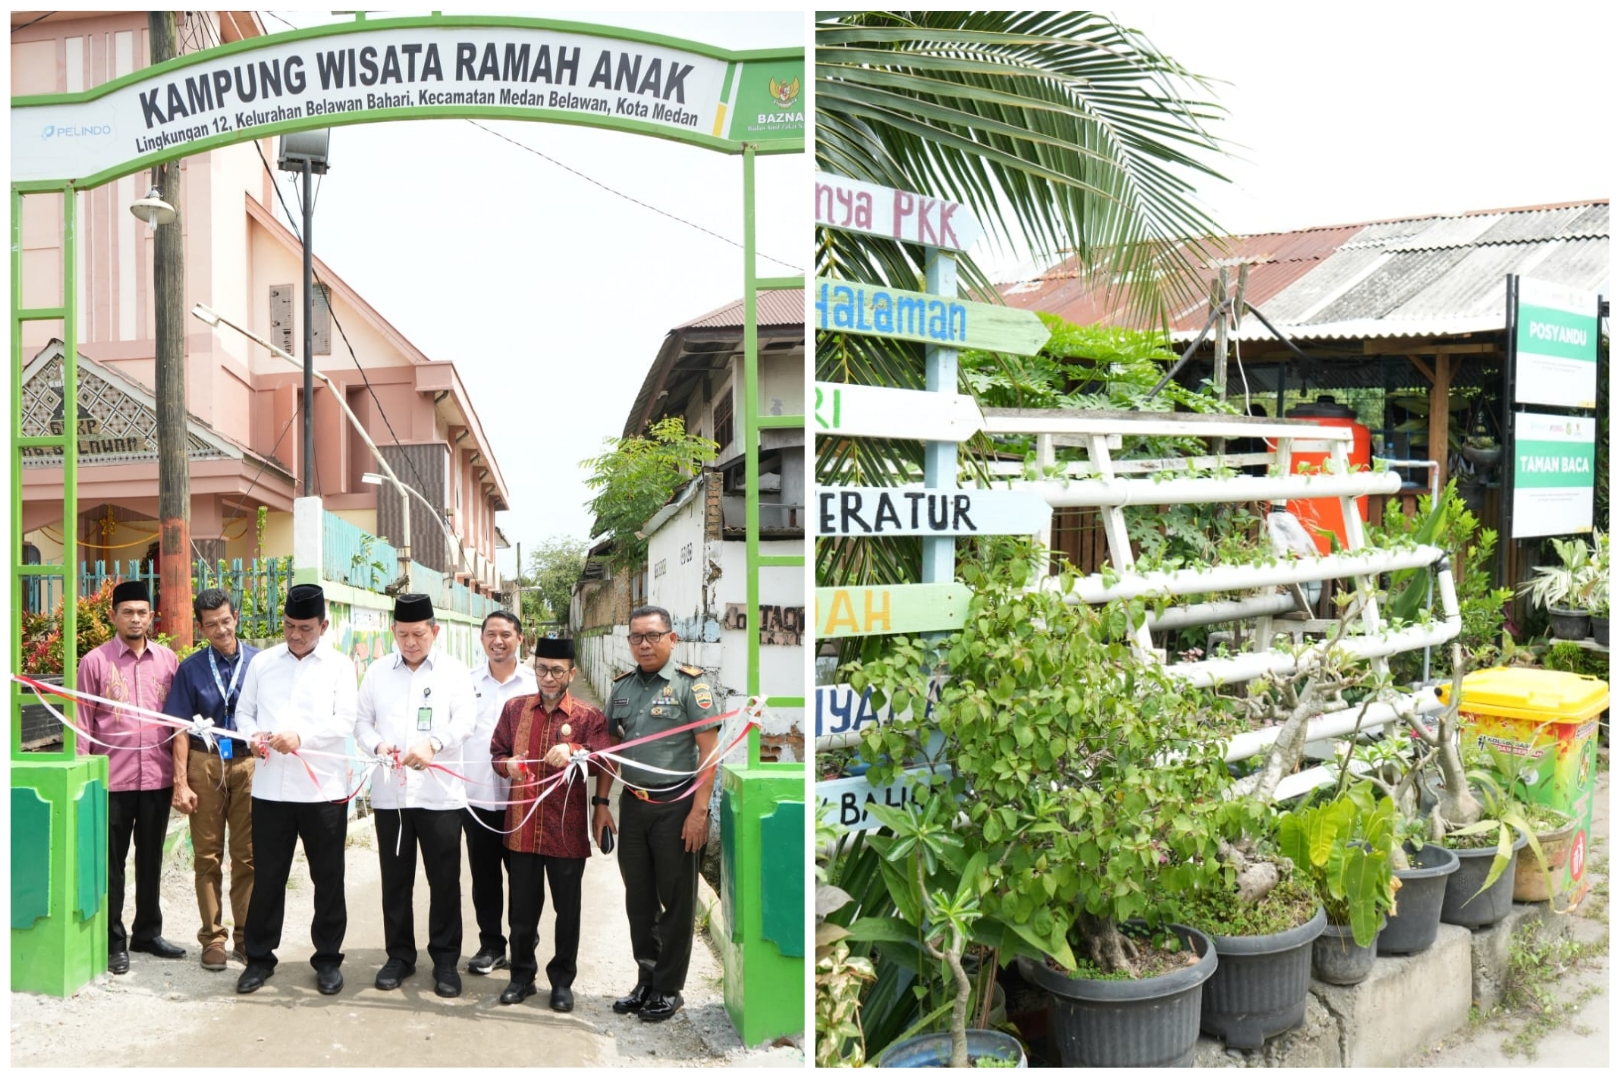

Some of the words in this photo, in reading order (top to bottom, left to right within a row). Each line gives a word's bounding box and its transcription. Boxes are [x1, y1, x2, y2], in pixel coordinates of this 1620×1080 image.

[139, 54, 307, 129] KAMPUNG
[316, 42, 444, 91] WISATA
[455, 42, 581, 86] RAMAH
[588, 50, 695, 105] ANAK
[57, 124, 111, 137] PELINDO
[135, 125, 209, 153] Lingkungan
[212, 115, 234, 133] 12,
[236, 106, 302, 129] Kelurahan
[305, 98, 363, 117] Belawan
[366, 90, 415, 109] Bahari,
[418, 89, 495, 105] Kecamatan
[499, 88, 545, 107] Medan
[548, 90, 611, 117] Belawan,
[615, 97, 649, 118] Kota
[652, 102, 698, 127] Medan
[893, 189, 960, 250] PKK
[1529, 321, 1587, 347] POSYANDU
[1520, 456, 1559, 472] TAMAN
[1561, 457, 1589, 472] BACA
[815, 491, 977, 533] ERATUR
[815, 590, 892, 635] AH
